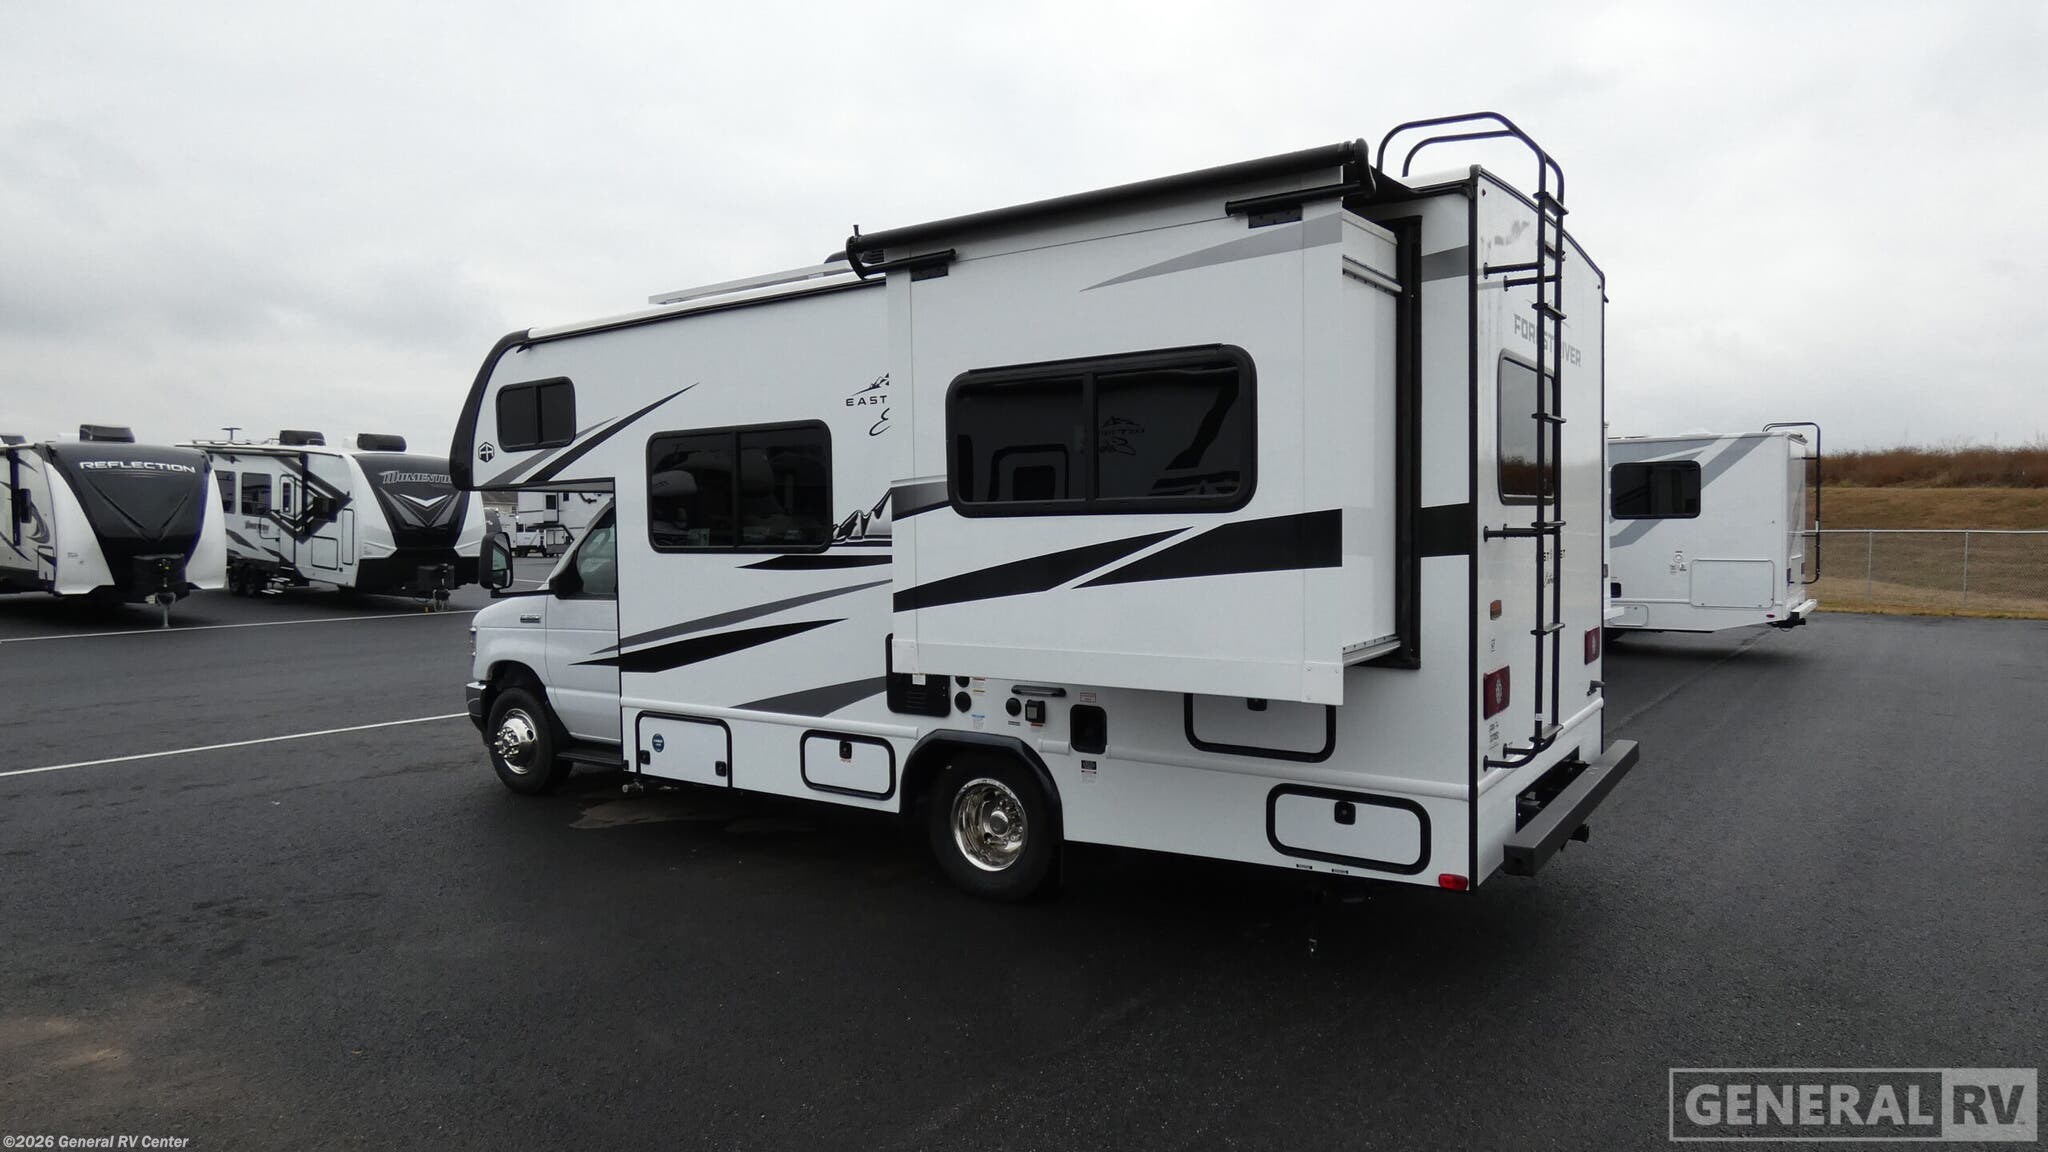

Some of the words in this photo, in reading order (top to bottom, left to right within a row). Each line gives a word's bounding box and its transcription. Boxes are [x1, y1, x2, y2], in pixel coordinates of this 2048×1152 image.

[1513, 313, 1555, 352] FORST
[846, 395, 887, 406] EAST
[79, 461, 196, 473] REFLECTION
[378, 470, 452, 484] MOMENTU
